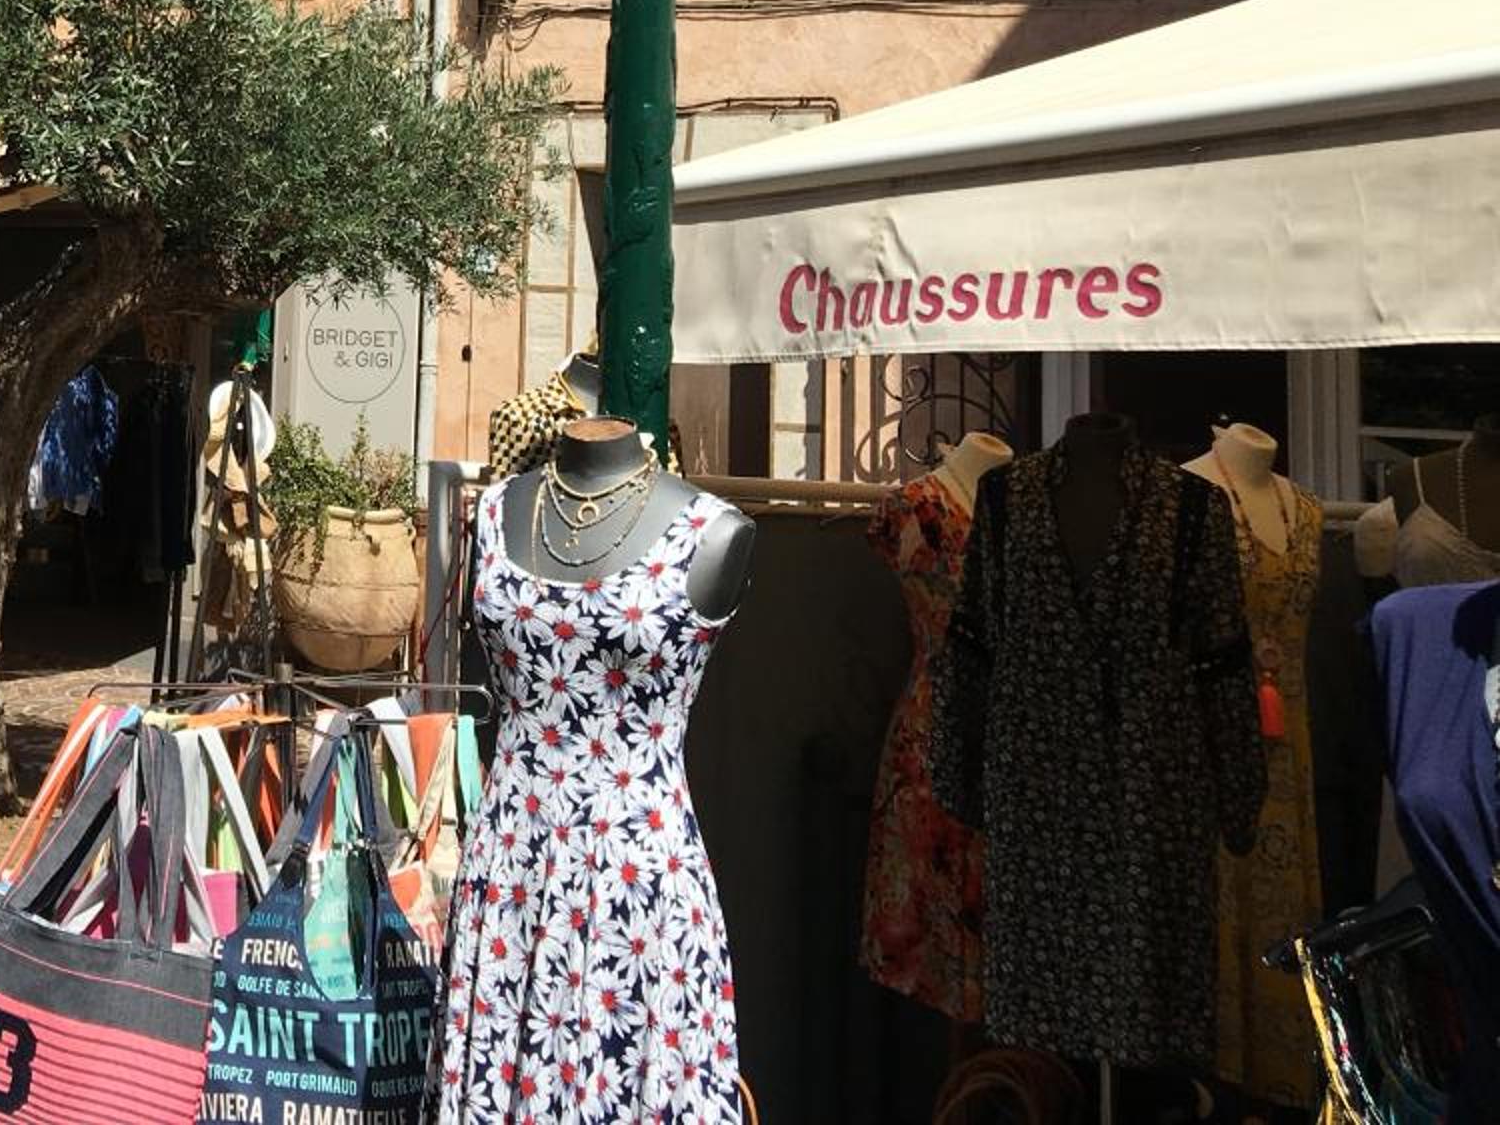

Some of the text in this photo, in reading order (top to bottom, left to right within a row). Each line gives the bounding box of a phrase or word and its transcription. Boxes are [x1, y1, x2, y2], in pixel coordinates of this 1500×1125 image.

[778, 262, 1162, 334] Chaussures
[313, 328, 398, 348] BRIDGET
[333, 350, 393, 368] & GIGI
[275, 977, 293, 996] DE
[209, 998, 431, 1069] SAINT TROPE
[208, 1063, 254, 1085] TROPEZ
[265, 1070, 298, 1088] PORT
[299, 1072, 358, 1097] GRIMAUD
[200, 1092, 263, 1125] IVIERA
